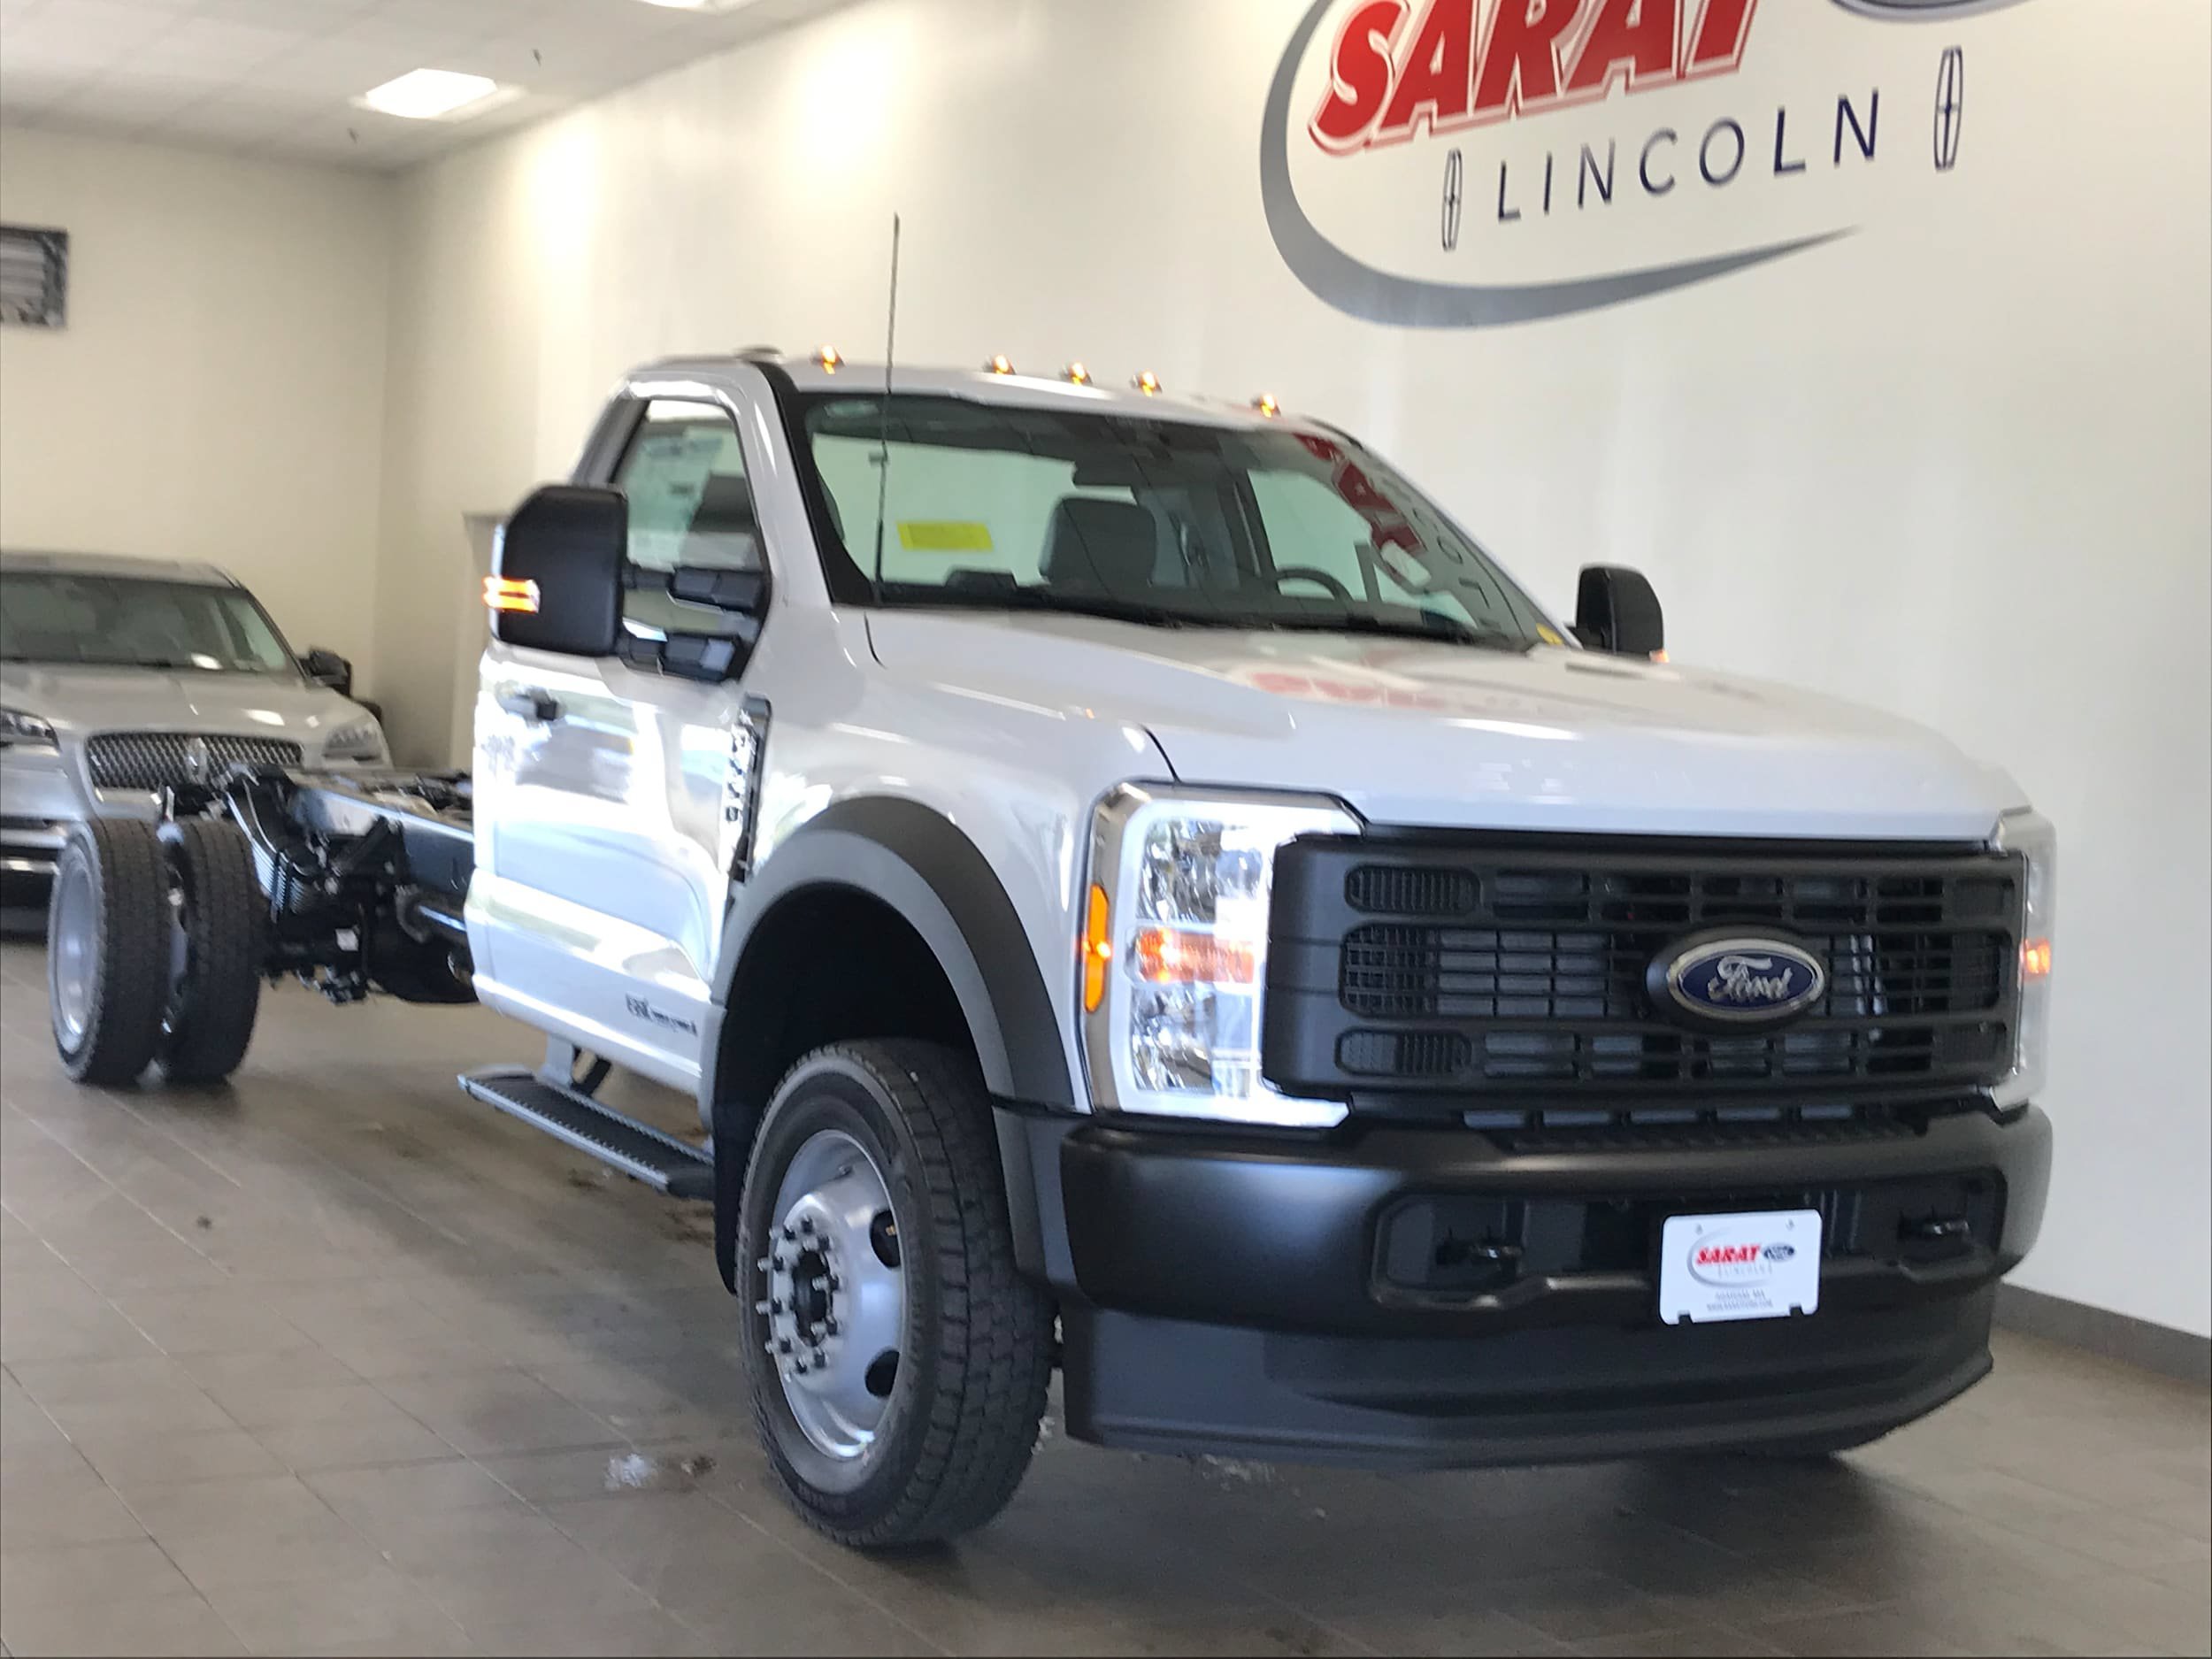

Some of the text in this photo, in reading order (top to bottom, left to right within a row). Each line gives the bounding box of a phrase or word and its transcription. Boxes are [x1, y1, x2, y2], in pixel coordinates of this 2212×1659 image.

[1497, 88, 1880, 223] LINCOLN
[1707, 955, 1793, 1003] Ford
[1695, 1243, 1761, 1266] SARAT
